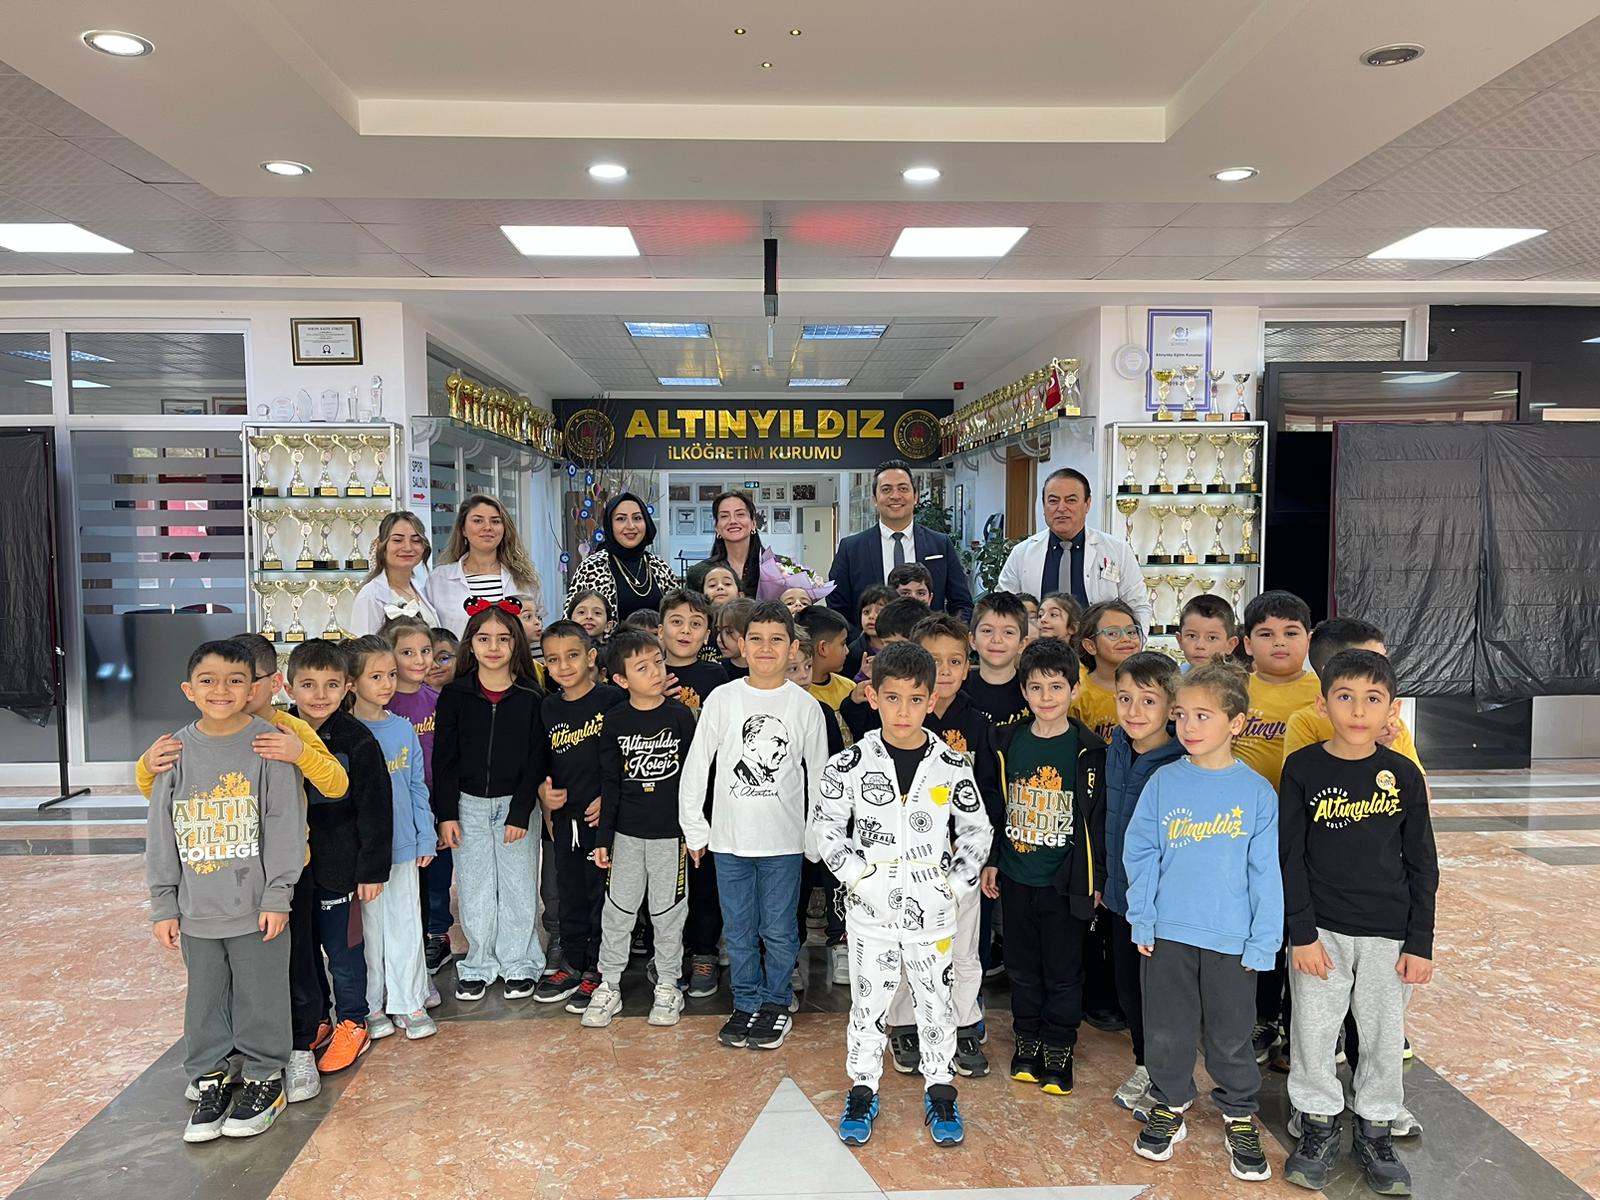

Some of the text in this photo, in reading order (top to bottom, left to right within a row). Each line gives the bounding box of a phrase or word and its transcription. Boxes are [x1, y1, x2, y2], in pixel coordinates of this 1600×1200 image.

[624, 409, 885, 439] ALTINYILDIZ
[769, 446, 842, 460] KURUMU
[626, 753, 680, 781] Koleji
[172, 796, 260, 823] ALTIN
[1313, 791, 1403, 823] Altınyıldız
[173, 820, 261, 848] YILDIZ
[1005, 825, 1067, 847] COLLEGE
[179, 843, 259, 862] COLLEGE
